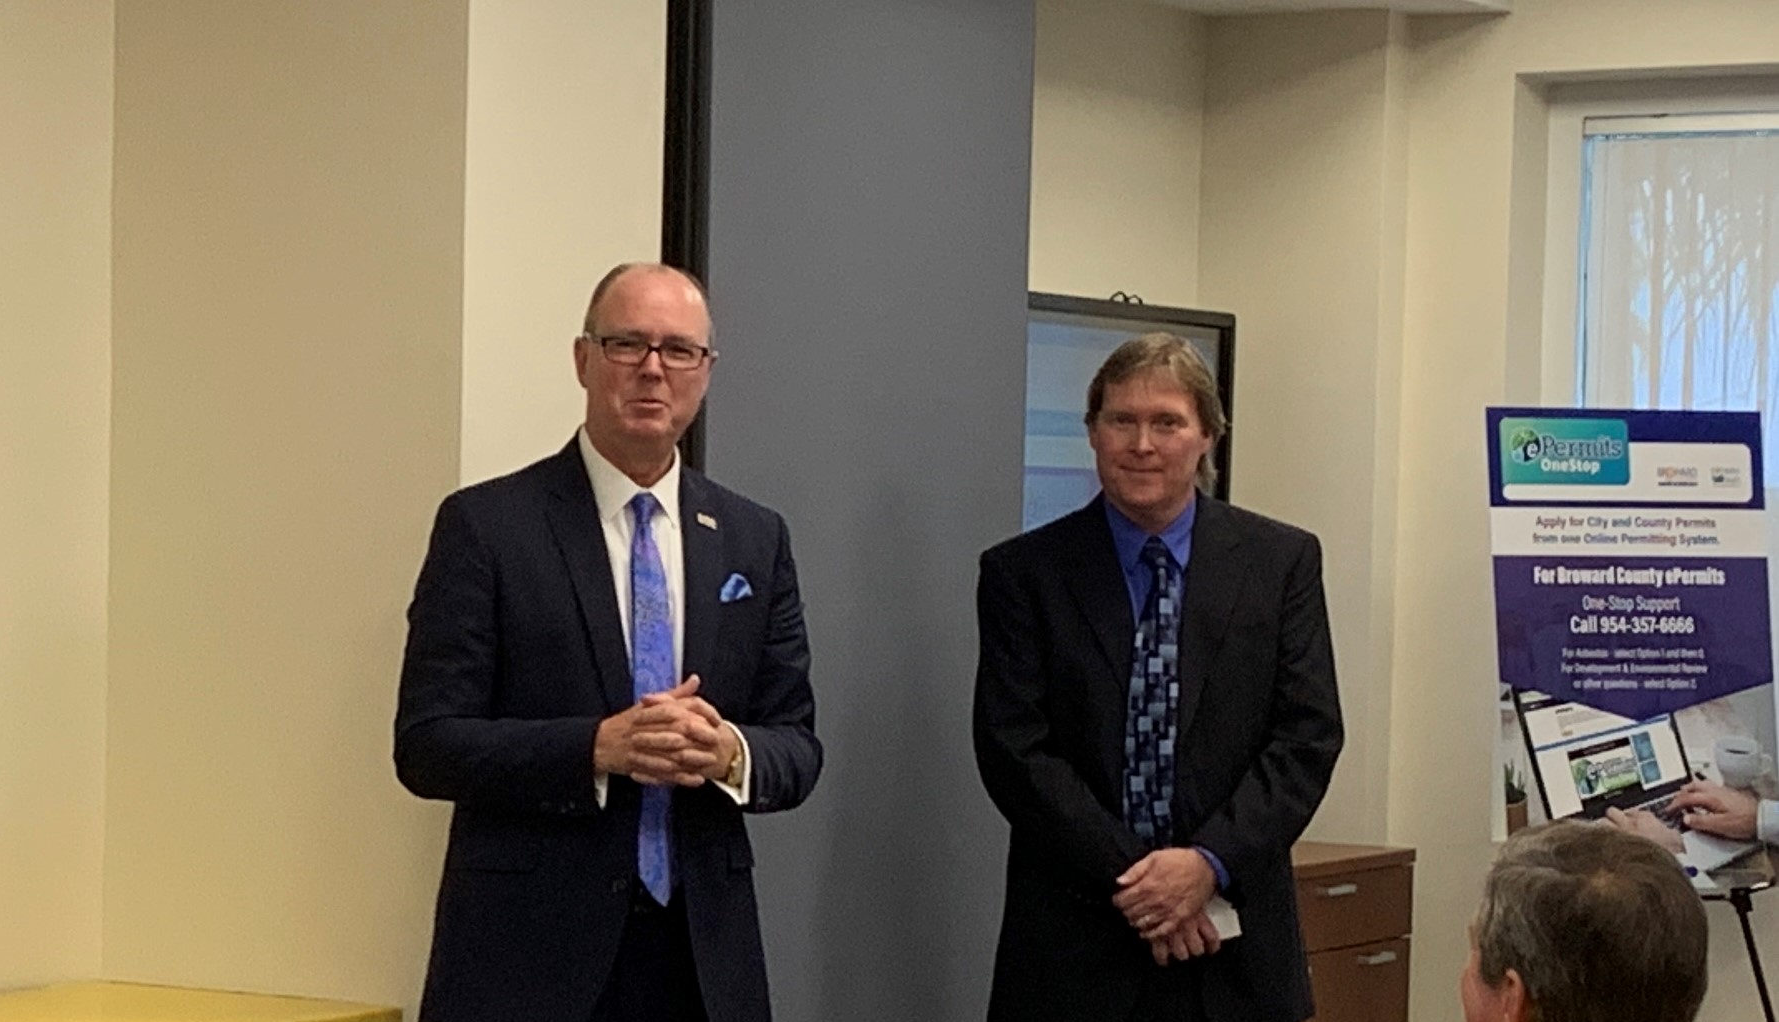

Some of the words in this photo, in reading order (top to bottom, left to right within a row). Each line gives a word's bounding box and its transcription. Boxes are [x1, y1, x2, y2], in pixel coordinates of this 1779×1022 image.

[1527, 436, 1621, 459] ePermits
[1541, 457, 1600, 474] OneStop
[1536, 516, 1566, 530] Apply
[1569, 517, 1584, 528] for
[1587, 517, 1608, 529] City
[1612, 517, 1631, 528] and
[1635, 518, 1672, 530] County
[1675, 517, 1716, 529] Permits
[1533, 533, 1558, 544] from
[1561, 535, 1581, 544] one
[1584, 533, 1618, 545] Online
[1621, 533, 1677, 547] Permitting
[1680, 534, 1720, 547] System.
[1533, 566, 1555, 585] For
[1557, 566, 1614, 585] Broward
[1616, 566, 1663, 588] County
[1665, 567, 1725, 585] ePermits
[1582, 595, 1634, 612] One-Stop
[1636, 595, 1681, 613] Support
[1570, 616, 1598, 634] Call
[1600, 616, 1694, 634] 954-357-6666
